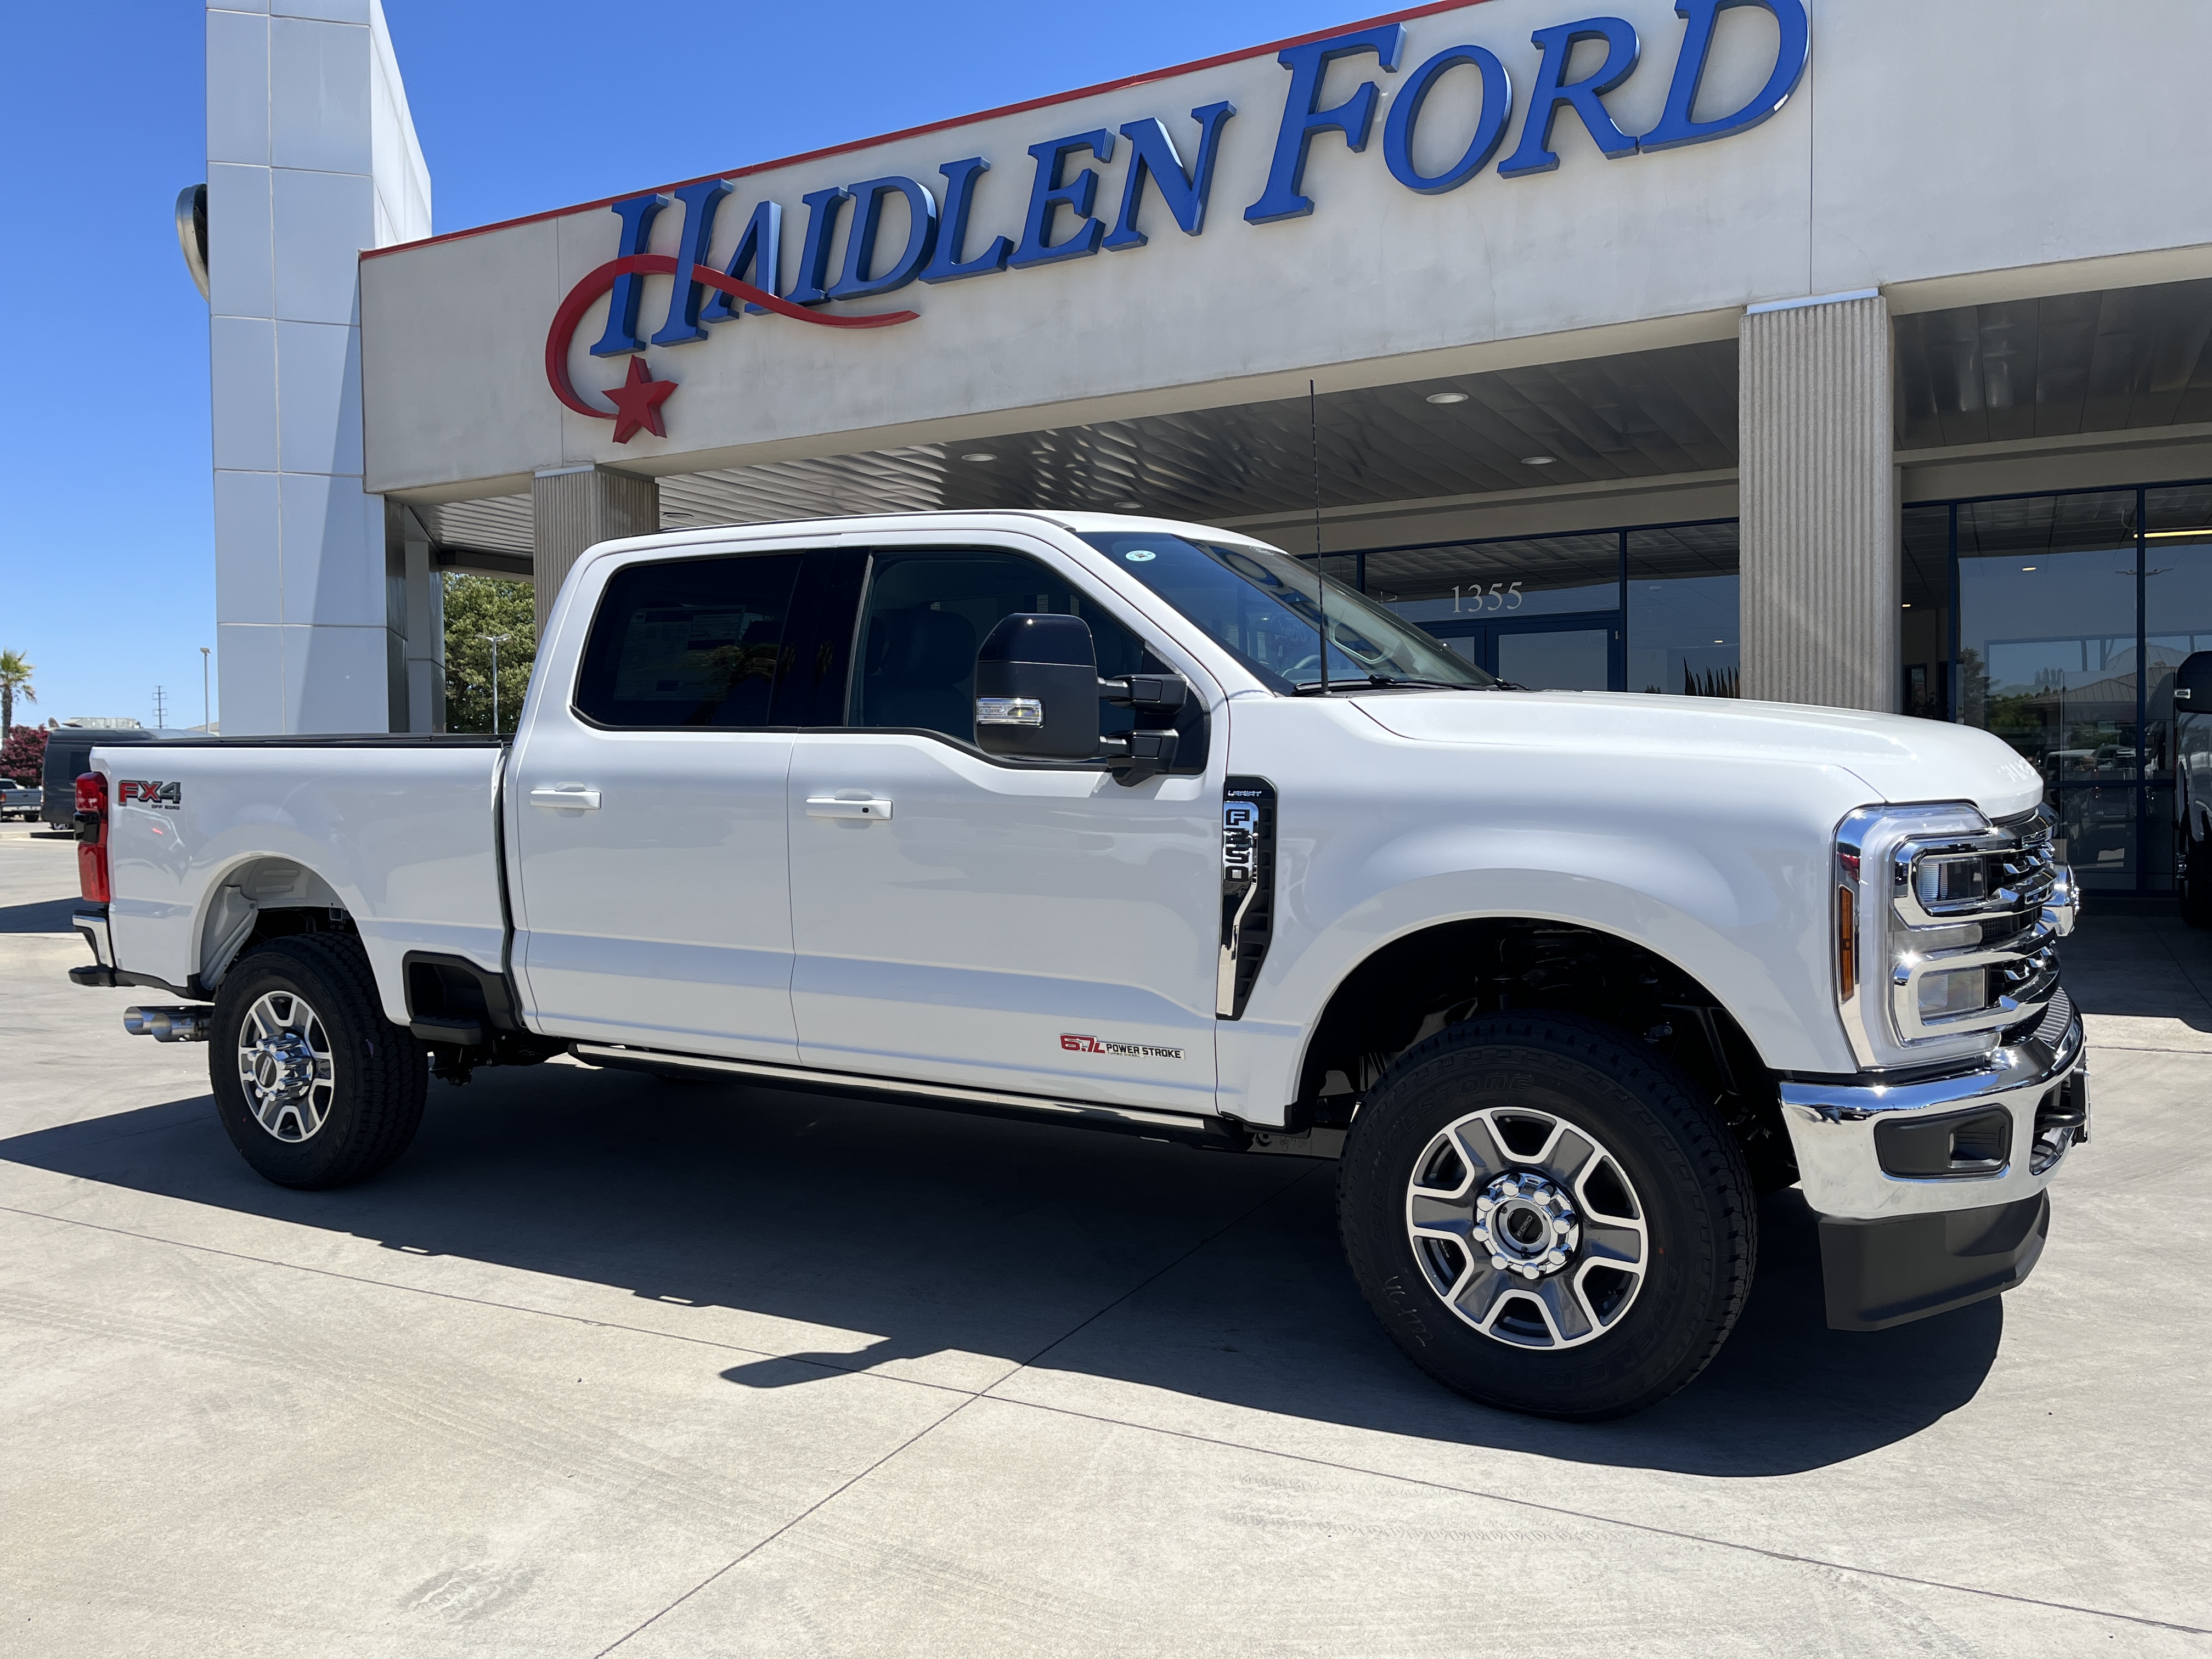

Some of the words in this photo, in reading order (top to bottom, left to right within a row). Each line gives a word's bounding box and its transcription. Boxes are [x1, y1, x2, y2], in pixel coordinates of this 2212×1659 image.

[590, 101, 1237, 357] HAIDLEN
[1244, 0, 1809, 225] FORD
[1452, 581, 1522, 613] 1355
[119, 780, 181, 806] FX4
[1060, 1035, 1105, 1053] 6.7L
[1106, 1043, 1140, 1054] POWER
[1142, 1047, 1181, 1059] STROKE
[1370, 1073, 1536, 1248] BRIDGESTONE
[1516, 1215, 1533, 1237] FORD
[1544, 1250, 1685, 1391] DUELER
